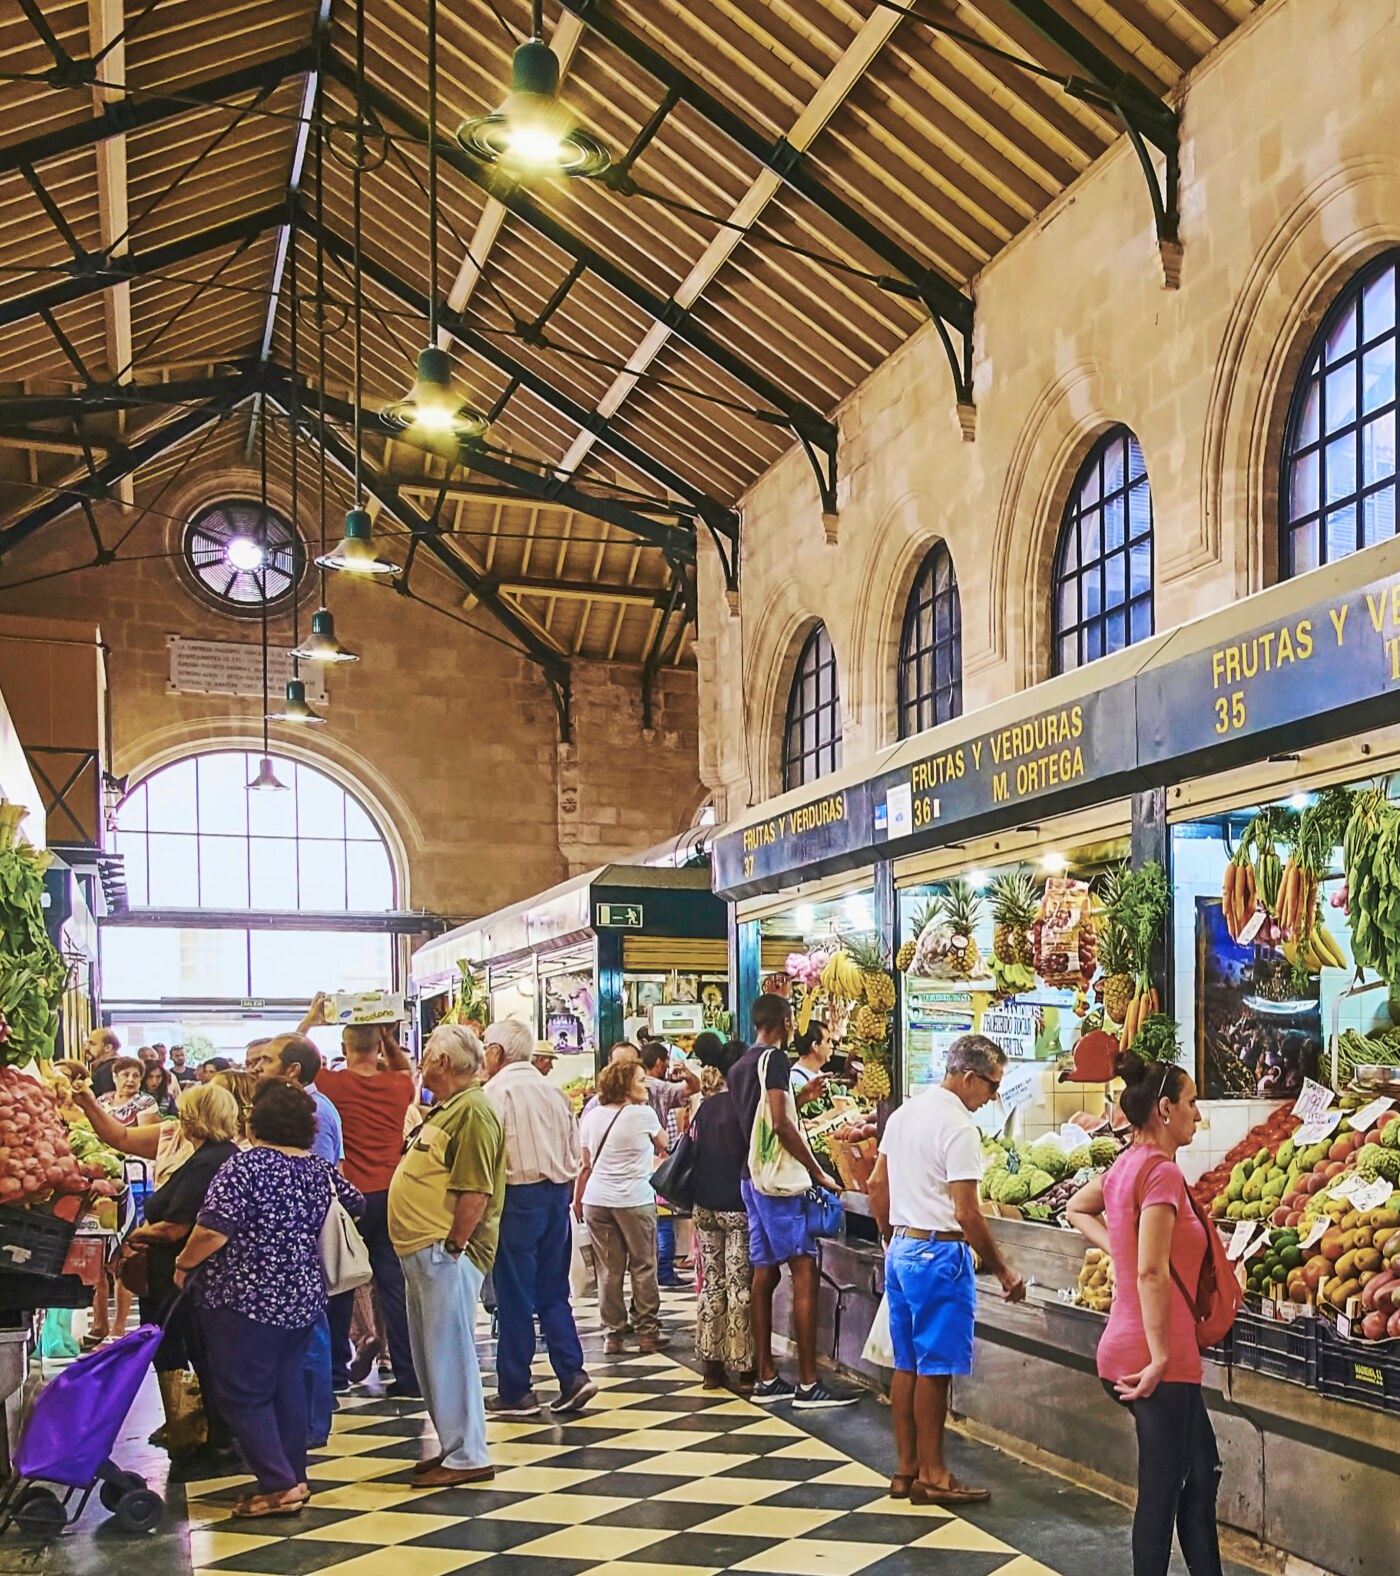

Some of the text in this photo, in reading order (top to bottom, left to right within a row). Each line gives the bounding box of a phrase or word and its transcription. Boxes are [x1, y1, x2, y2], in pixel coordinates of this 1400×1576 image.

[1212, 620, 1314, 689] FRUTAS
[1329, 604, 1349, 646] Y
[1214, 691, 1246, 734] 35
[912, 705, 1083, 793] FRUTAS Y VERDURAS
[992, 746, 1084, 803] M. ORTEGA
[743, 795, 843, 852] FRUTAS Y VERDURAS
[914, 796, 931, 827] 36
[744, 855, 754, 879] 37
